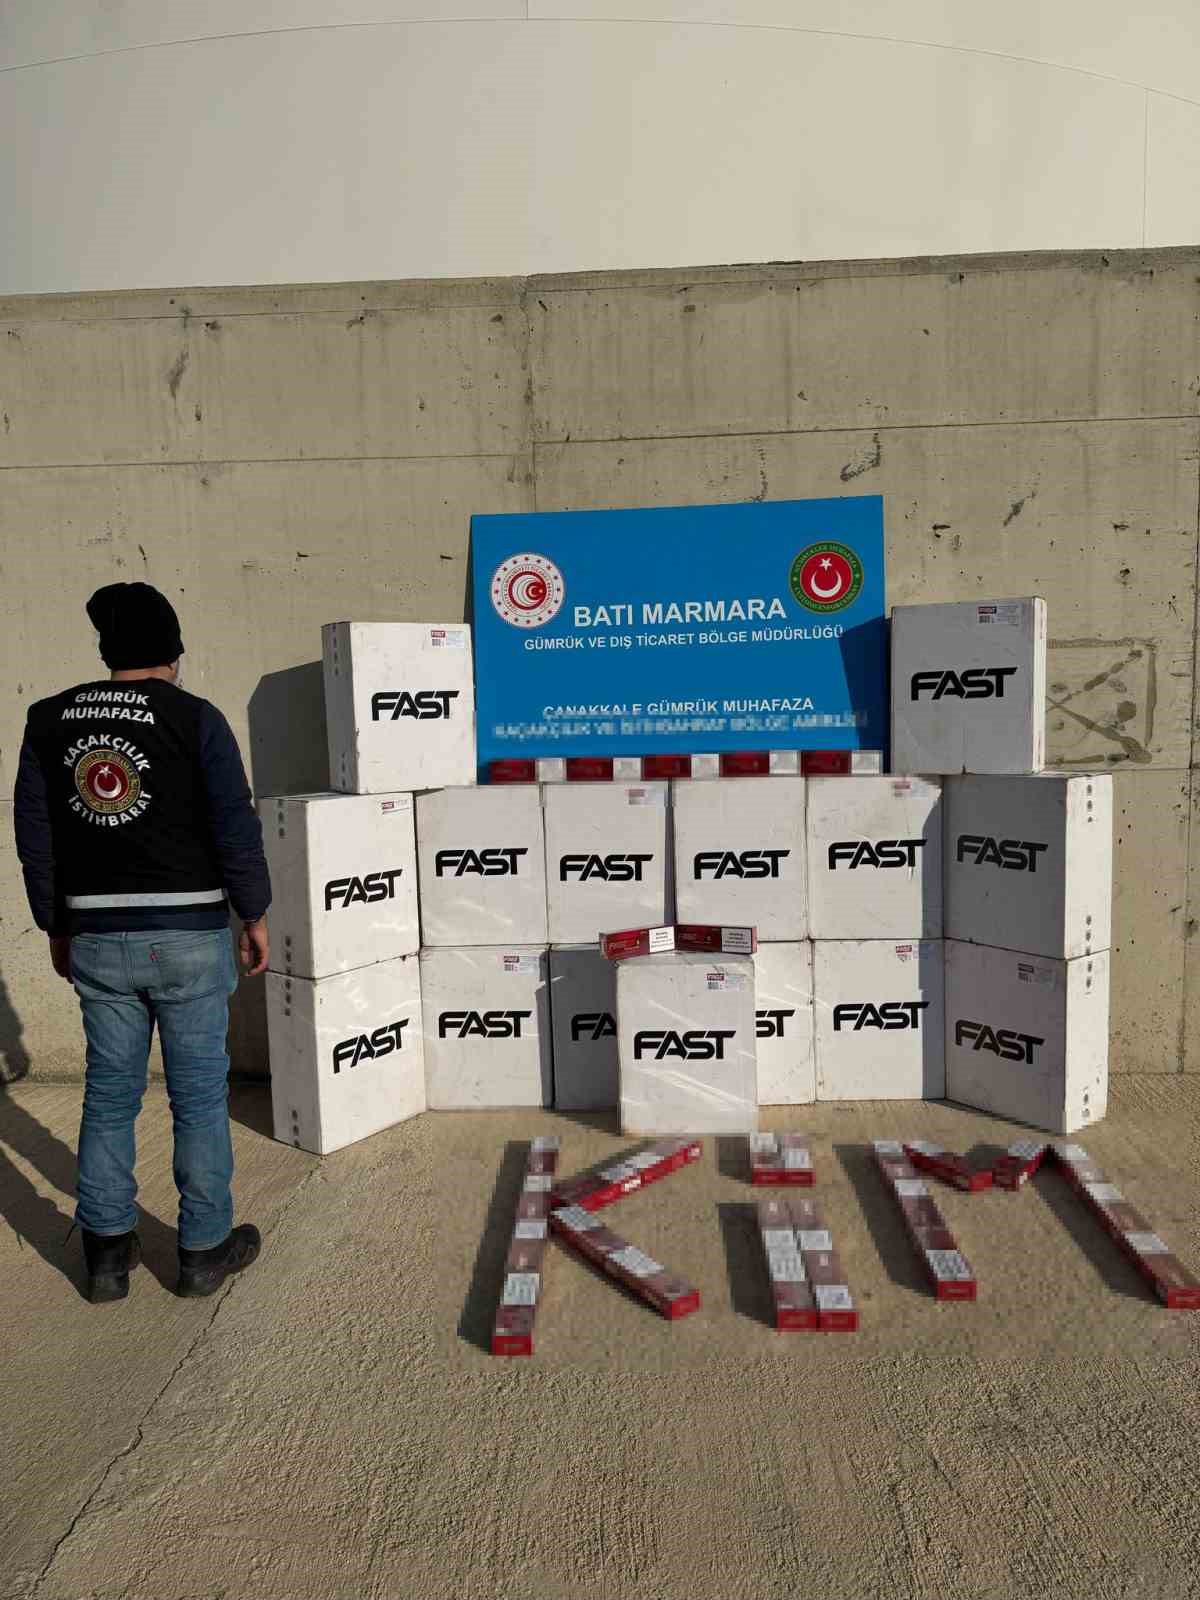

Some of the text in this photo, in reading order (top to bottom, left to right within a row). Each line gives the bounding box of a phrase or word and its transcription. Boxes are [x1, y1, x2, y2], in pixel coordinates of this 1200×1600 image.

[574, 598, 787, 627] BATI MARMARA
[524, 624, 844, 650] GÜMRÜK VE DIŞ TİCARET BÖLGE MÜDÜRLÜĞÜ
[75, 690, 149, 705] GÜMRÜK
[911, 667, 1017, 700] FAST
[61, 707, 155, 724] MUHAFAZA
[371, 690, 459, 721] FAST
[647, 699, 718, 715] GÜMRÜK
[723, 697, 814, 712] MUHAFAZA
[63, 734, 151, 771] KAÇAKÇILIK
[68, 791, 152, 827] İSTİHBARAT
[435, 848, 528, 877] FAST
[560, 854, 653, 881] FAST
[694, 850, 790, 879] FAST
[828, 839, 927, 870] FAST
[957, 835, 1048, 872] FAST
[325, 869, 402, 911] FAST
[438, 1011, 532, 1038] FAST
[571, 1013, 617, 1041] FA
[833, 1001, 930, 1031] FAST
[332, 1018, 409, 1074] FAST
[633, 1031, 736, 1060] FAST
[955, 1019, 1045, 1064] FAST
